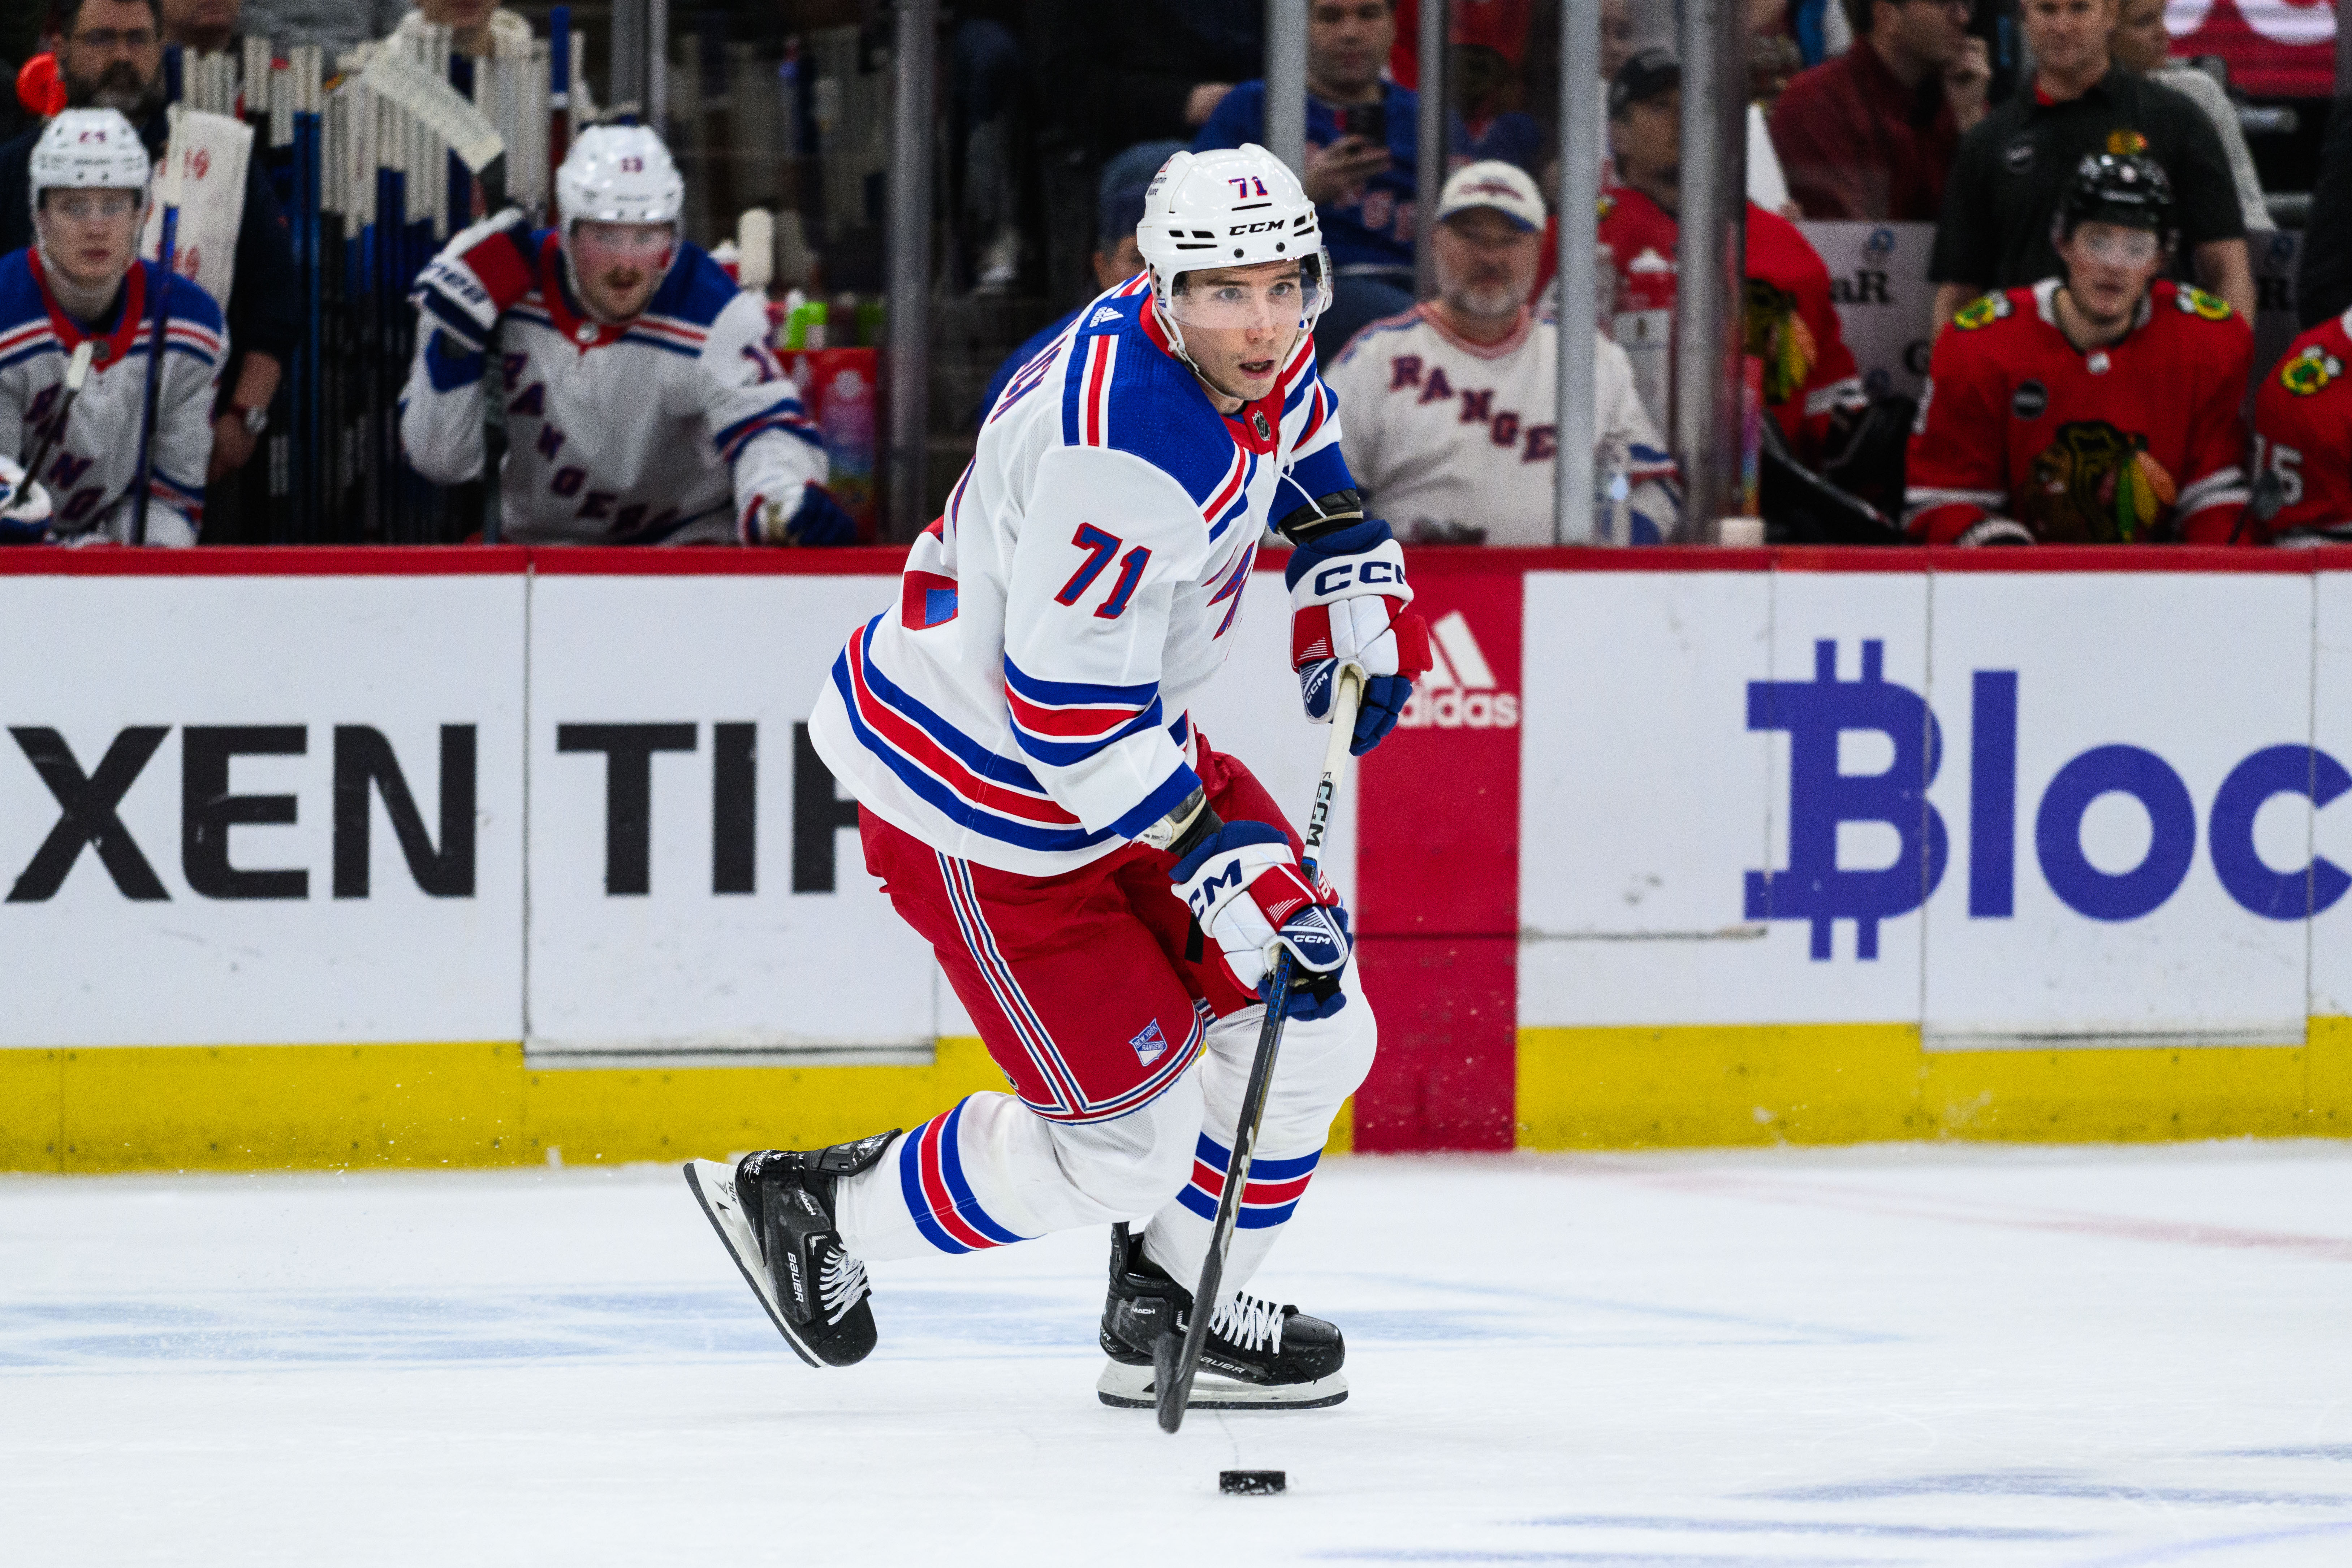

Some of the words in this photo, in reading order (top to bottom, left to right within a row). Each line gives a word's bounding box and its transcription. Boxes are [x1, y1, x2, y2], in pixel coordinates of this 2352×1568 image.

[1229, 176, 1268, 199] 71
[1229, 219, 1285, 236] CCM
[1089, 307, 1107, 328] adidas
[1054, 522, 1152, 620] 71
[1306, 672, 1329, 704] CCM
[7, 724, 476, 902] XEN
[1306, 780, 1333, 847] CCM
[1744, 640, 2352, 960] Bloc
[1188, 858, 1243, 924] CM
[1293, 934, 1331, 945] CCM
[1268, 950, 1292, 1018] ETSPEED
[1134, 1035, 1146, 1049] NEW
[798, 1189, 816, 1216] MACH
[1199, 1355, 1246, 1374] AUER
